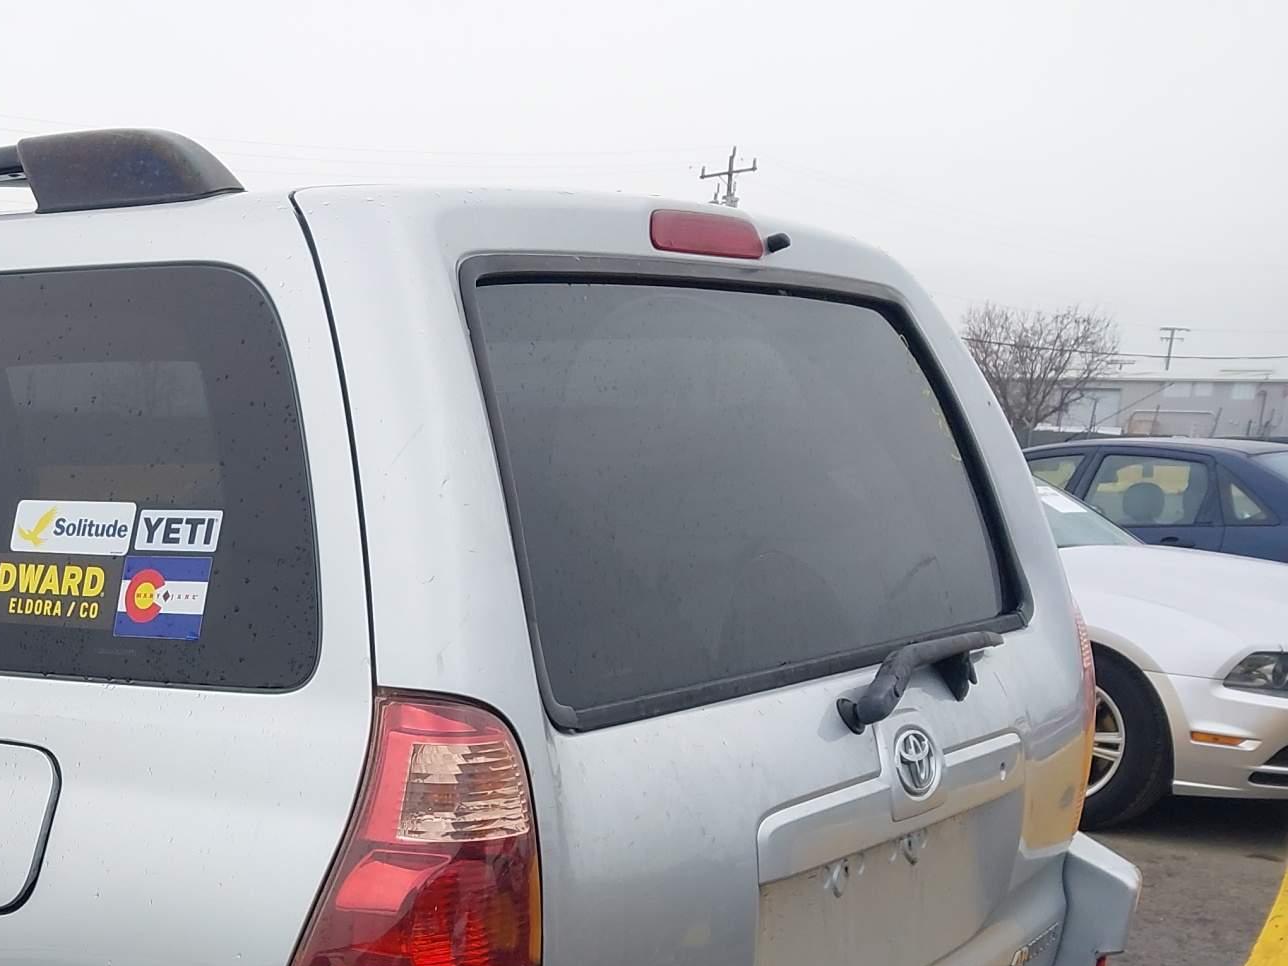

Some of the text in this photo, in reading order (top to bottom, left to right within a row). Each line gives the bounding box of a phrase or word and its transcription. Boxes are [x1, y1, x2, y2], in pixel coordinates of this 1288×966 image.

[53, 518, 128, 539] Solitude
[143, 518, 216, 545] YETI
[8, 597, 99, 619] ELDORA / CO
